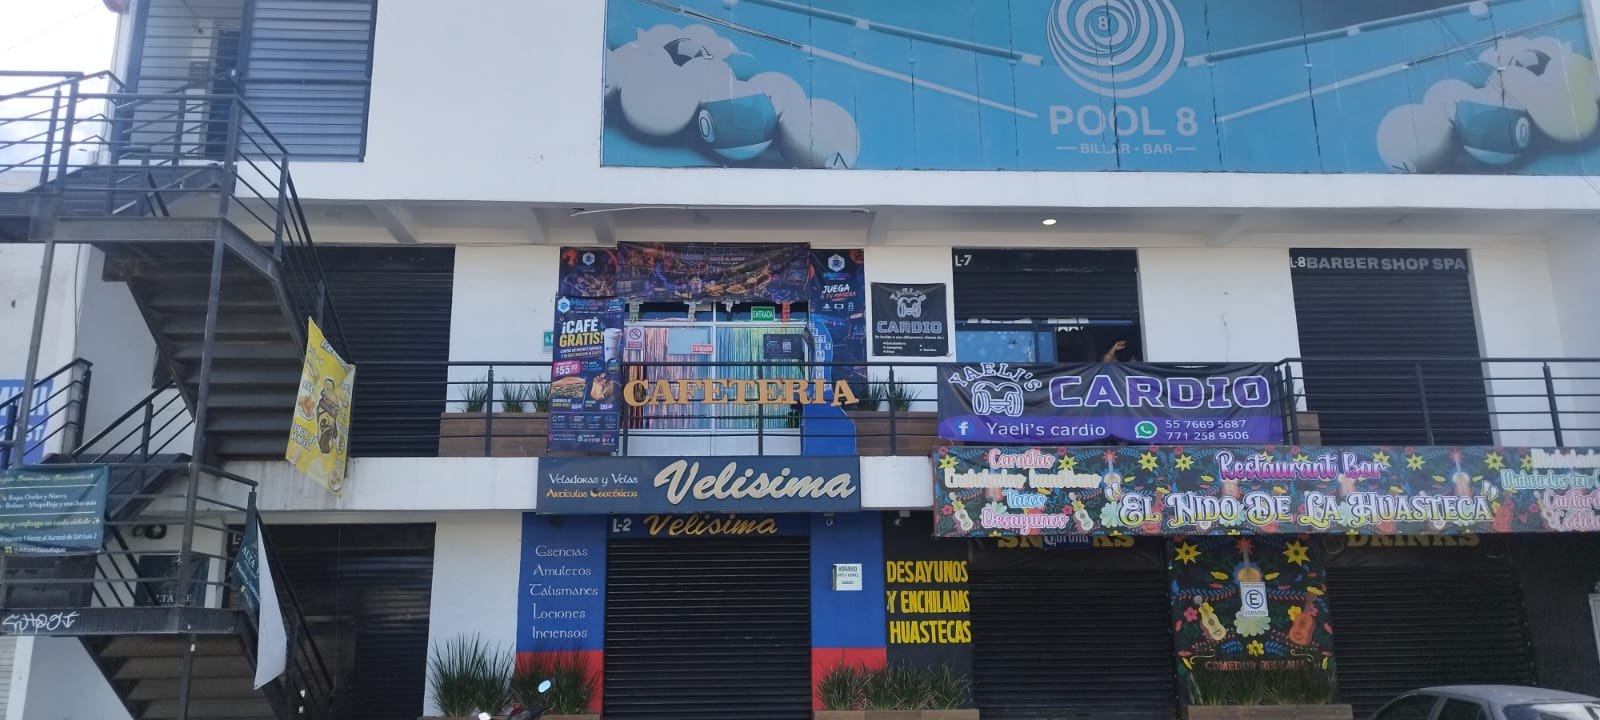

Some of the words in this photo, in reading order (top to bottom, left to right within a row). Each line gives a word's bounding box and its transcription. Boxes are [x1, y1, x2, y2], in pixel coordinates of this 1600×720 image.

[1098, 16, 1109, 31] 8
[1049, 105, 1166, 136] POOL
[1176, 106, 1199, 137] 8
[1080, 143, 1131, 154] BILLAR
[1143, 143, 1173, 154] BAR
[954, 254, 972, 267] L-7
[1289, 256, 1306, 268] L-8
[1307, 257, 1380, 270] BARBER
[1381, 258, 1429, 271] SHOP
[1432, 258, 1467, 271] SPA
[821, 283, 851, 294] JUEGA
[752, 310, 774, 319] ENTRADA
[561, 316, 599, 334] ¡CAFÉ
[876, 320, 943, 335] CARDIO
[559, 331, 605, 348] GRATIS!
[948, 362, 1042, 393] YAELI'S
[623, 378, 860, 407] CAFETERIA
[1048, 374, 1271, 410] CARDIO
[986, 421, 1046, 437] Yaeli's
[1050, 423, 1107, 437] cardio
[1165, 420, 1181, 429] 55
[1184, 420, 1215, 430] 7669
[1217, 420, 1246, 429] 5687
[1166, 431, 1189, 441] 771
[1194, 431, 1216, 441] 258
[1219, 431, 1250, 441] 9506
[989, 448, 1056, 469] Carnitas
[1215, 450, 1338, 481] Restaurant
[1341, 450, 1388, 481] Bar
[601, 477, 609, 487] y
[611, 473, 638, 484] Velas
[654, 460, 857, 504] Velisima
[612, 517, 632, 533] L-2
[643, 513, 778, 536] Velisima
[981, 508, 1069, 534] Desayunos
[535, 544, 588, 557] Esencias
[533, 564, 592, 577] Amuletos
[886, 560, 969, 584] DESAYUNOS
[528, 583, 599, 596] Talismanes
[886, 590, 898, 614] Y
[900, 590, 970, 614] ENCHILADAS
[533, 602, 586, 619] Lociones
[532, 626, 588, 639] Inciensos
[889, 620, 972, 644] HUASTECAS
